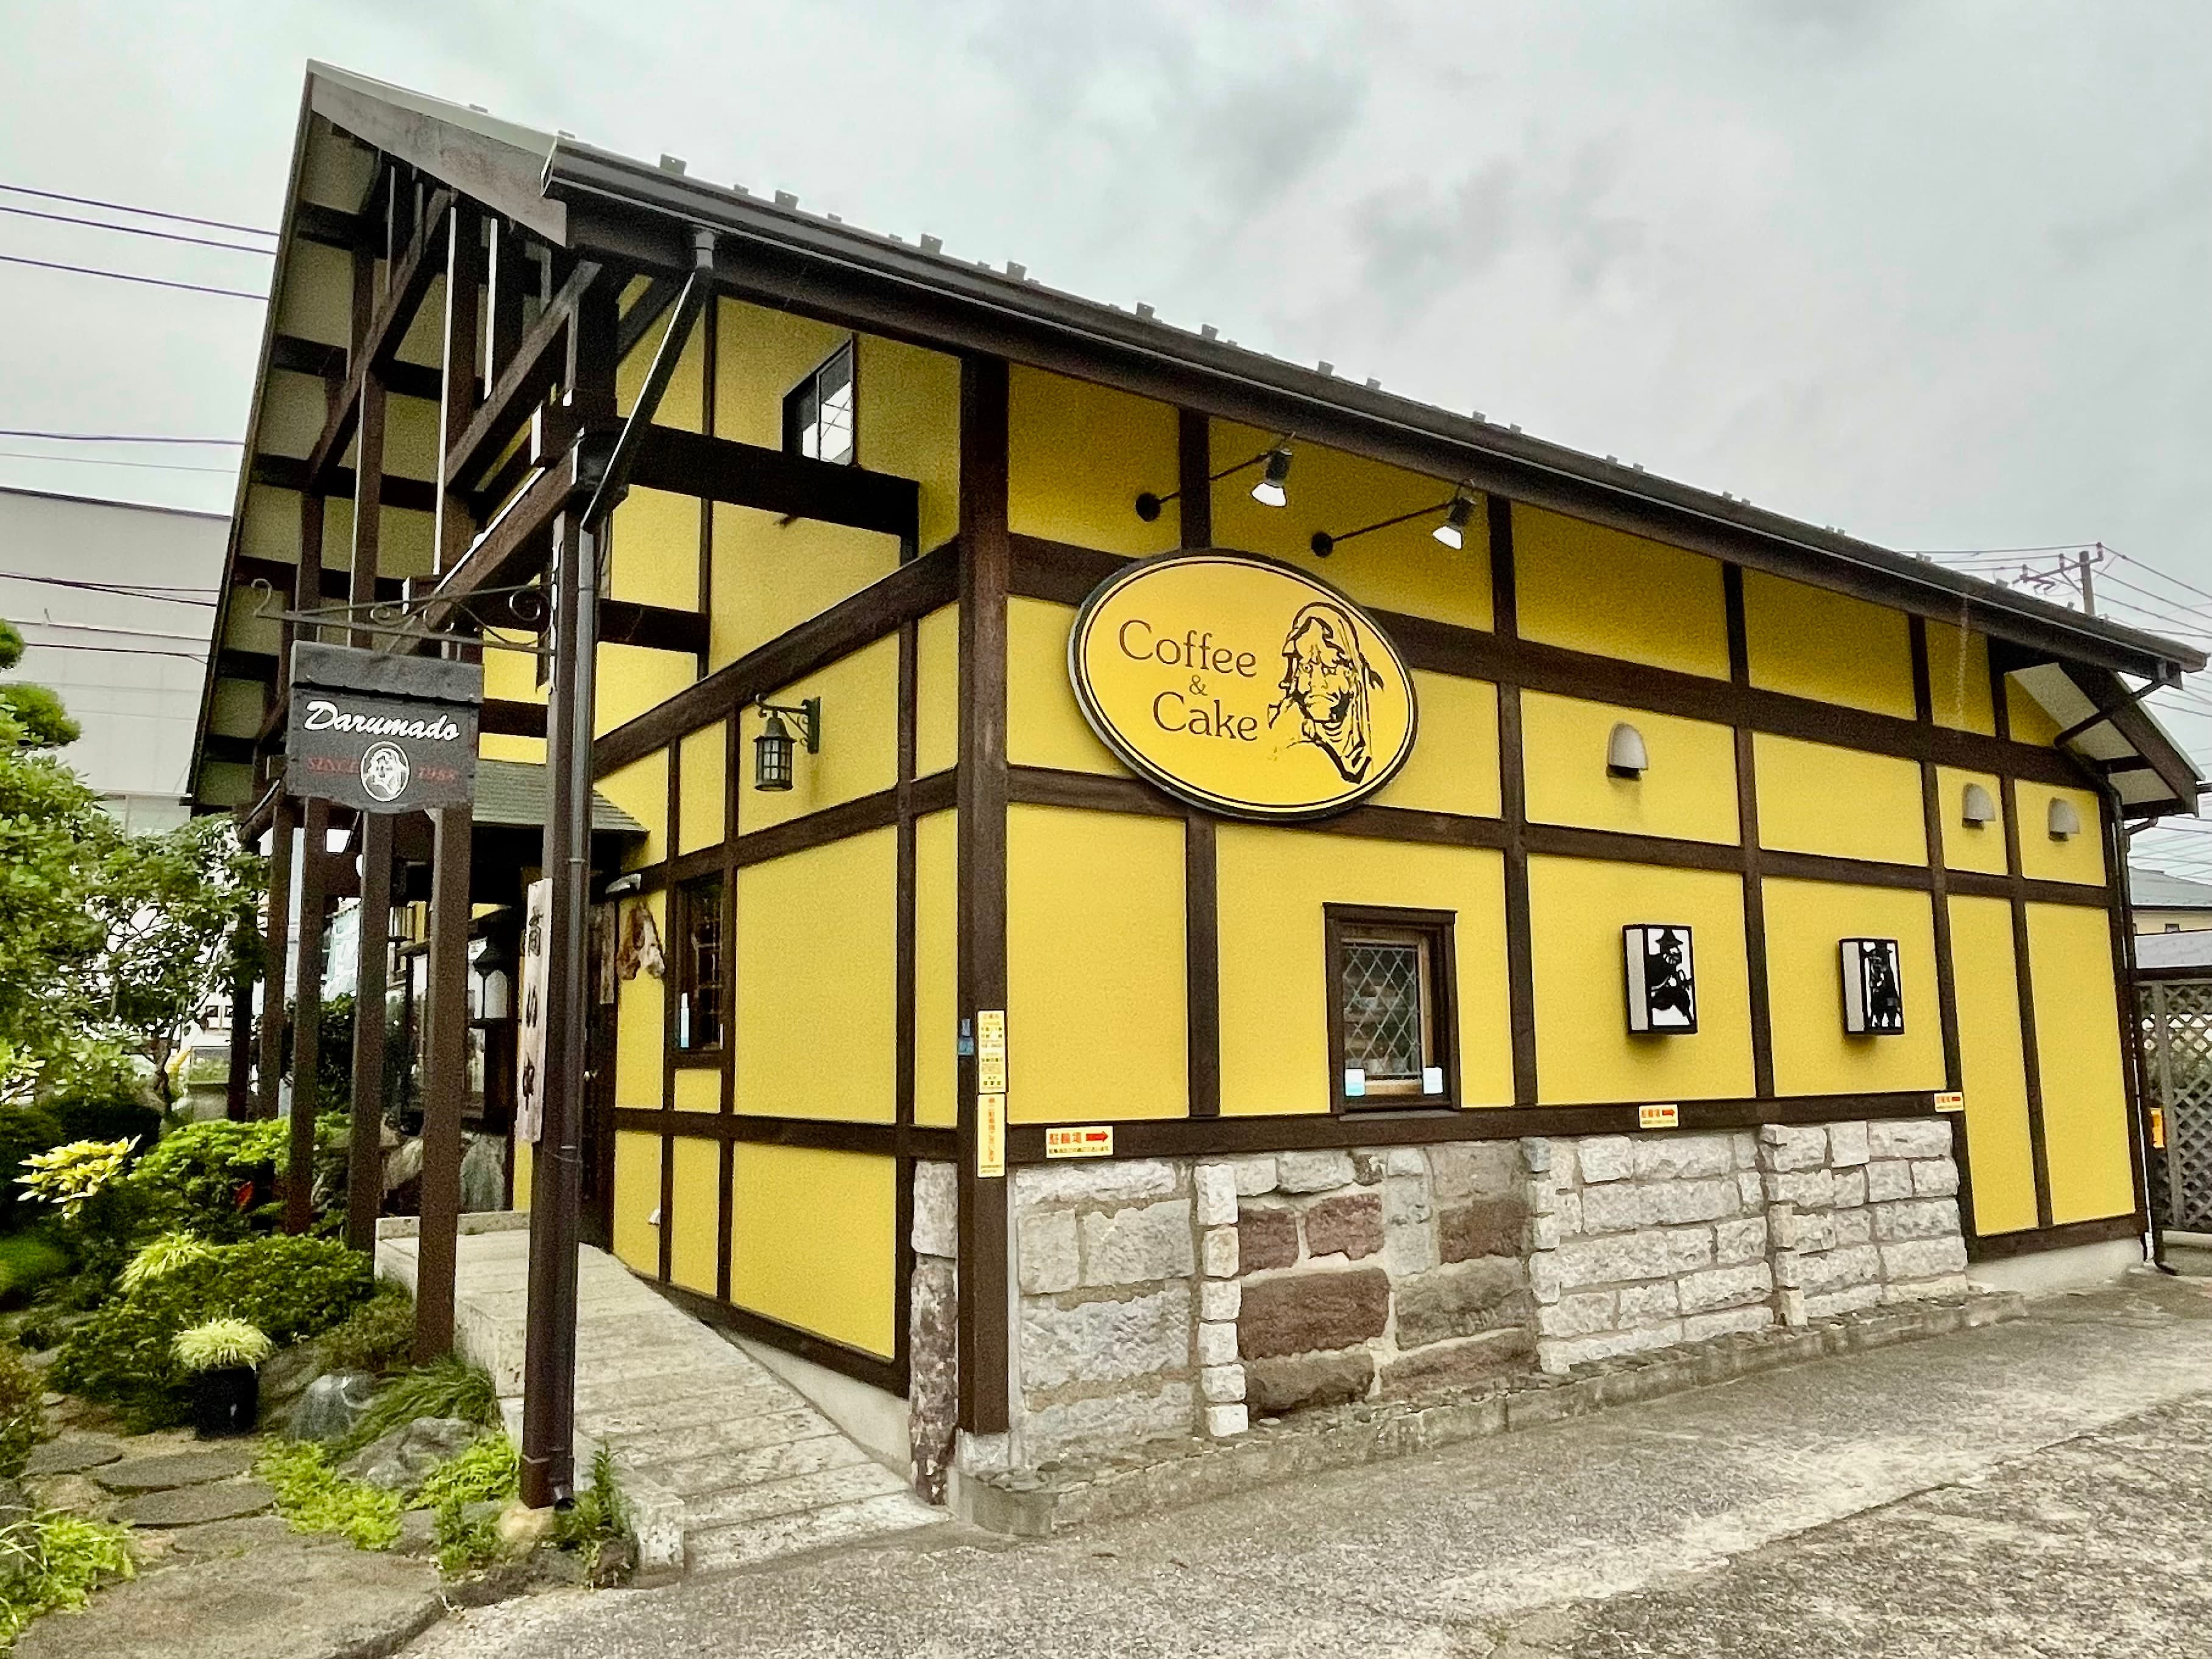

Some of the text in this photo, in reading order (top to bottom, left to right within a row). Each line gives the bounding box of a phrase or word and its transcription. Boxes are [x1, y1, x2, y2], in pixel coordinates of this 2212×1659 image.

[1119, 619, 1257, 678] Coffee
[1189, 674, 1208, 697] &
[303, 701, 460, 741] Darumado
[1152, 691, 1258, 742] Cake
